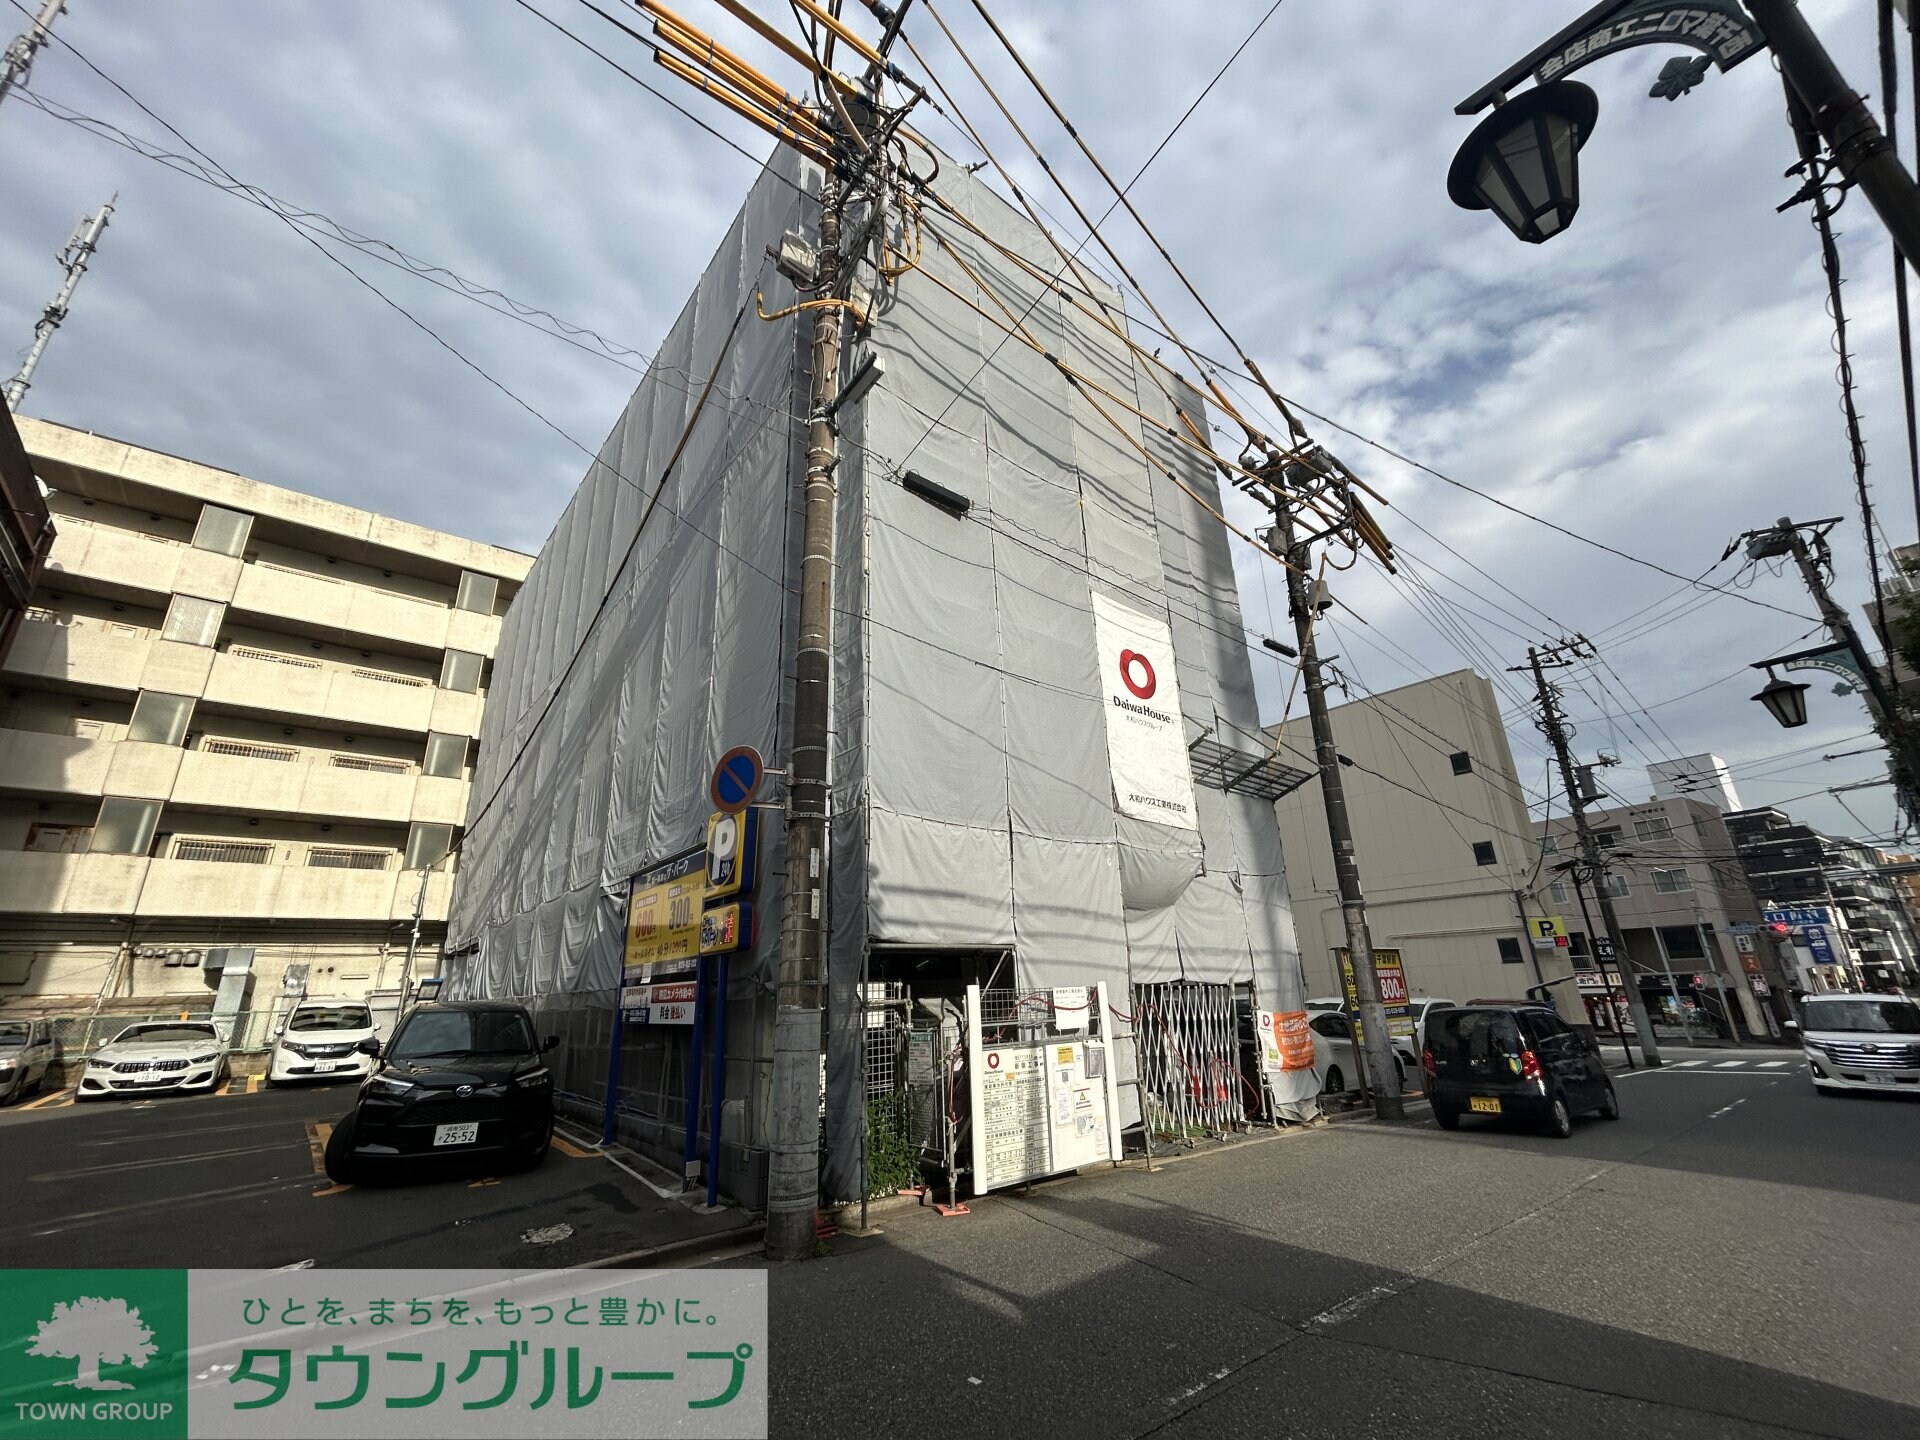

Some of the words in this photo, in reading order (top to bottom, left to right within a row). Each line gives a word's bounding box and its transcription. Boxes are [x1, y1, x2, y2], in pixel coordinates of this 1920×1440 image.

[1113, 695, 1172, 724] DaiwaHouse
[1128, 792, 1188, 814] 大和ハウス工業株式会社
[711, 818, 736, 881] P
[1538, 920, 1554, 937] P
